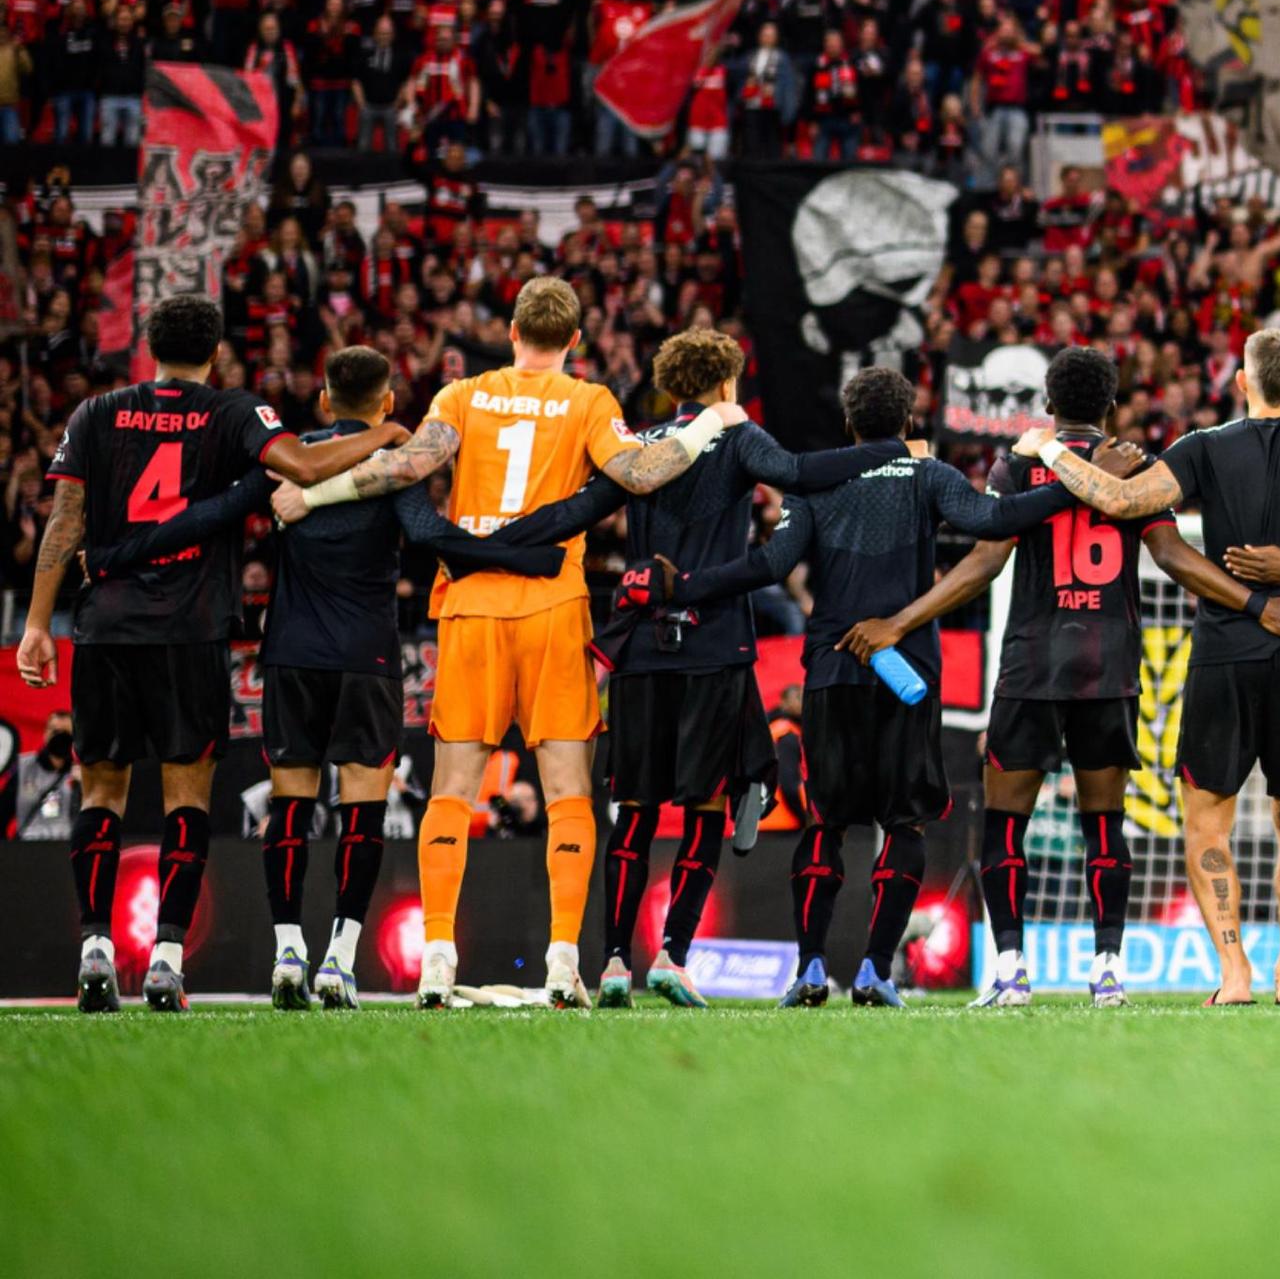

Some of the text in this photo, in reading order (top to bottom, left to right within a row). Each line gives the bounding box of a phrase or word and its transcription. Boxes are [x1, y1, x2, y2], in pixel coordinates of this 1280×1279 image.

[115, 409, 183, 432] BAYER
[471, 391, 571, 418] BAYER 04
[127, 441, 189, 524] 4
[496, 419, 537, 513] 1
[1043, 507, 1123, 587] 16
[1057, 589, 1101, 610] TAPE
